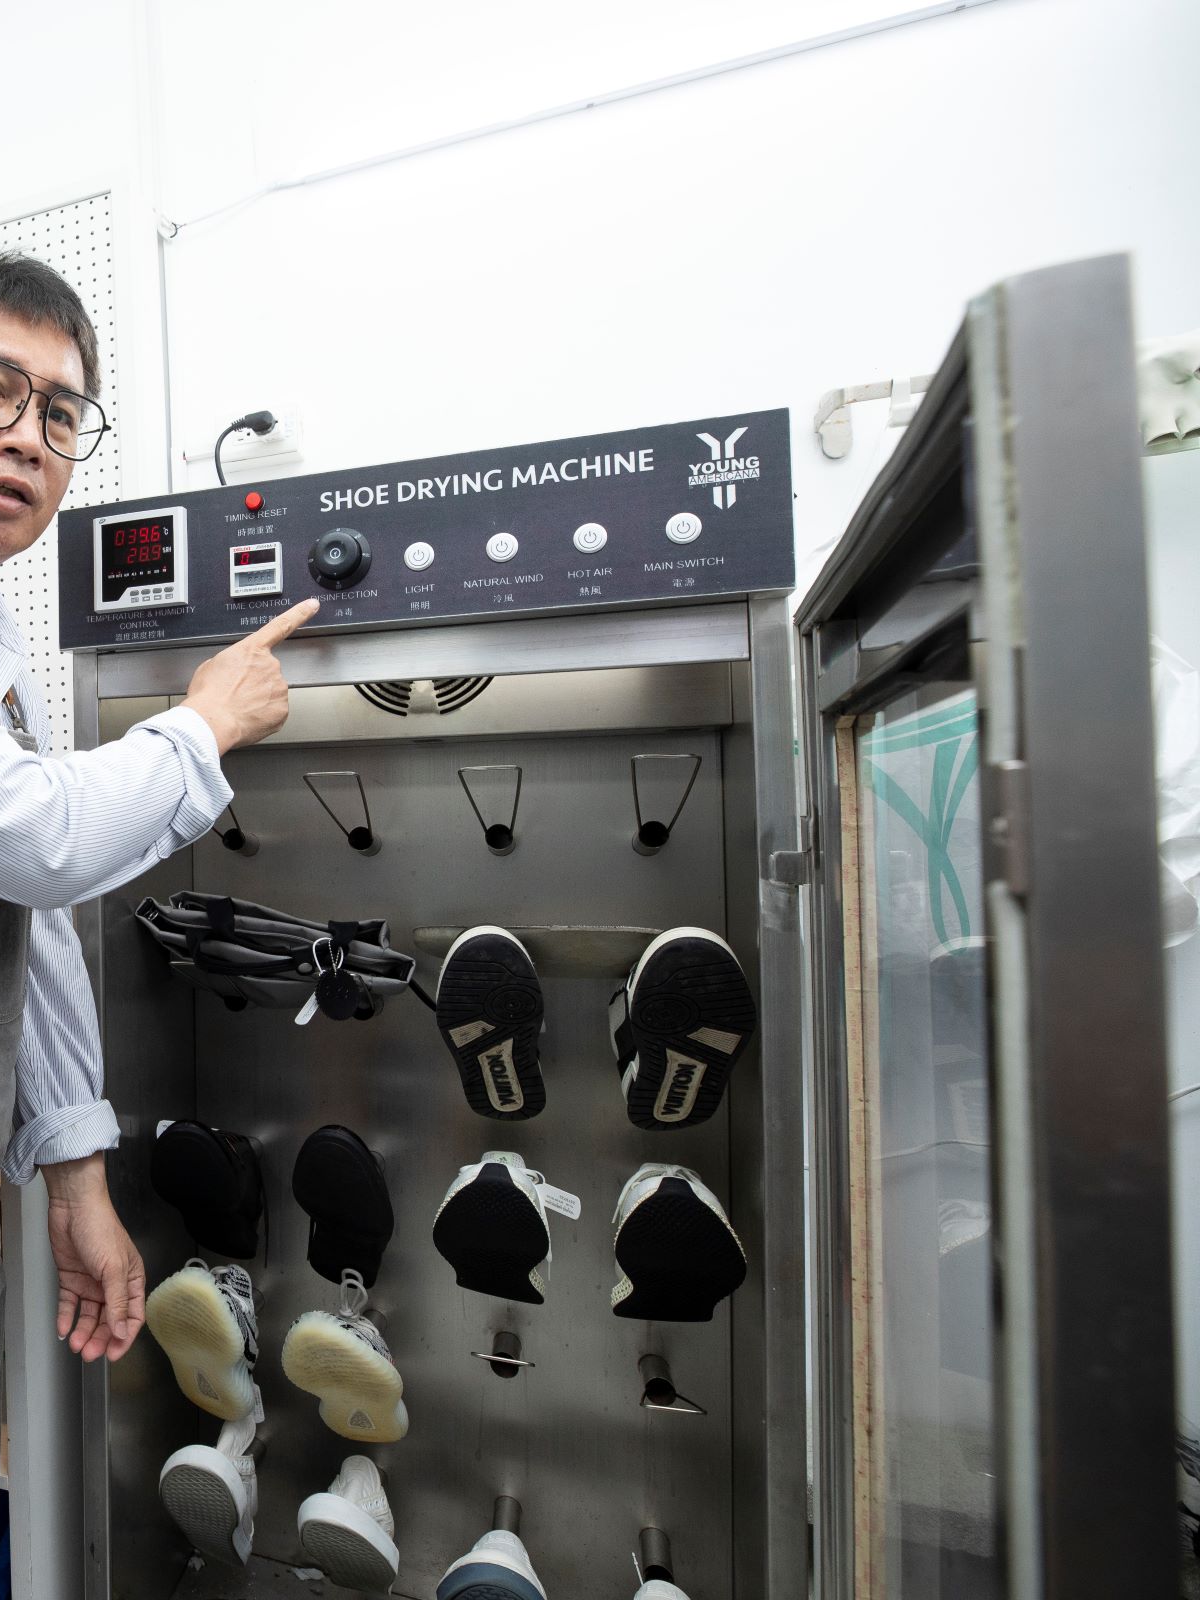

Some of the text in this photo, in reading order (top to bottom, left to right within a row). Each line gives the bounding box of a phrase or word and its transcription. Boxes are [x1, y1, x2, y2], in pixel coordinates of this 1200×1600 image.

[688, 456, 760, 476] YOUNG
[320, 448, 655, 512] SHOE DRYING MACHINE
[688, 468, 760, 486] AMERICANA
[224, 507, 288, 523] TIMING RESET
[644, 556, 724, 572] MAIN SWITCH
[464, 573, 544, 589] NATURAL WIND
[567, 567, 613, 579] HOT AIR
[405, 584, 435, 594] LIGHT
[672, 577, 695, 588] 電源
[493, 593, 514, 603] 冷風
[579, 585, 602, 597] 熱風
[226, 598, 292, 611] TIME CONTROL
[410, 600, 430, 611] 照明
[86, 606, 196, 623] TEMPERATURE & HUMIDITY
[119, 620, 160, 630] CONTROL
[486, 1054, 517, 1106] VUITTON
[661, 1063, 698, 1115] VUITTON
